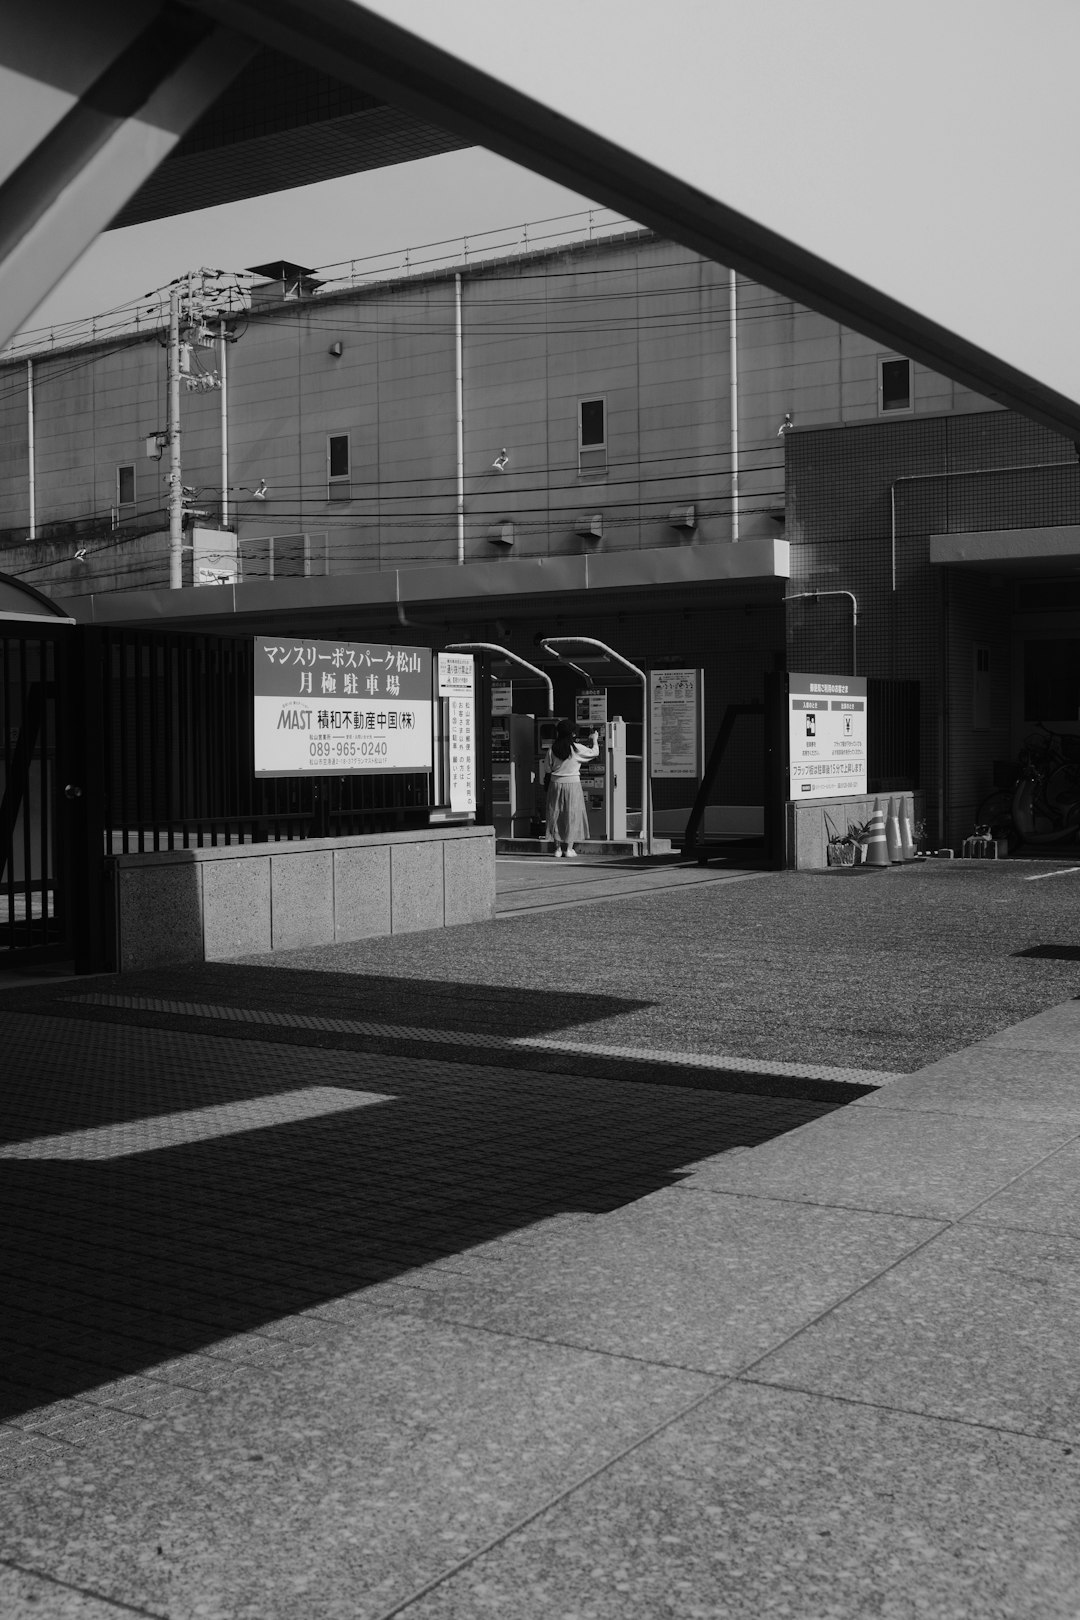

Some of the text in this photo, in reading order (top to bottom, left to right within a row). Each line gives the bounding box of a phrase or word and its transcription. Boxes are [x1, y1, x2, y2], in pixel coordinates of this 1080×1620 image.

[263, 645, 421, 673] マンスリーポスパーク松山
[299, 672, 401, 696] 月極駐車場
[277, 709, 416, 730] MAST 積和不動産中国(株)
[309, 741, 388, 757] 089-965-0240
